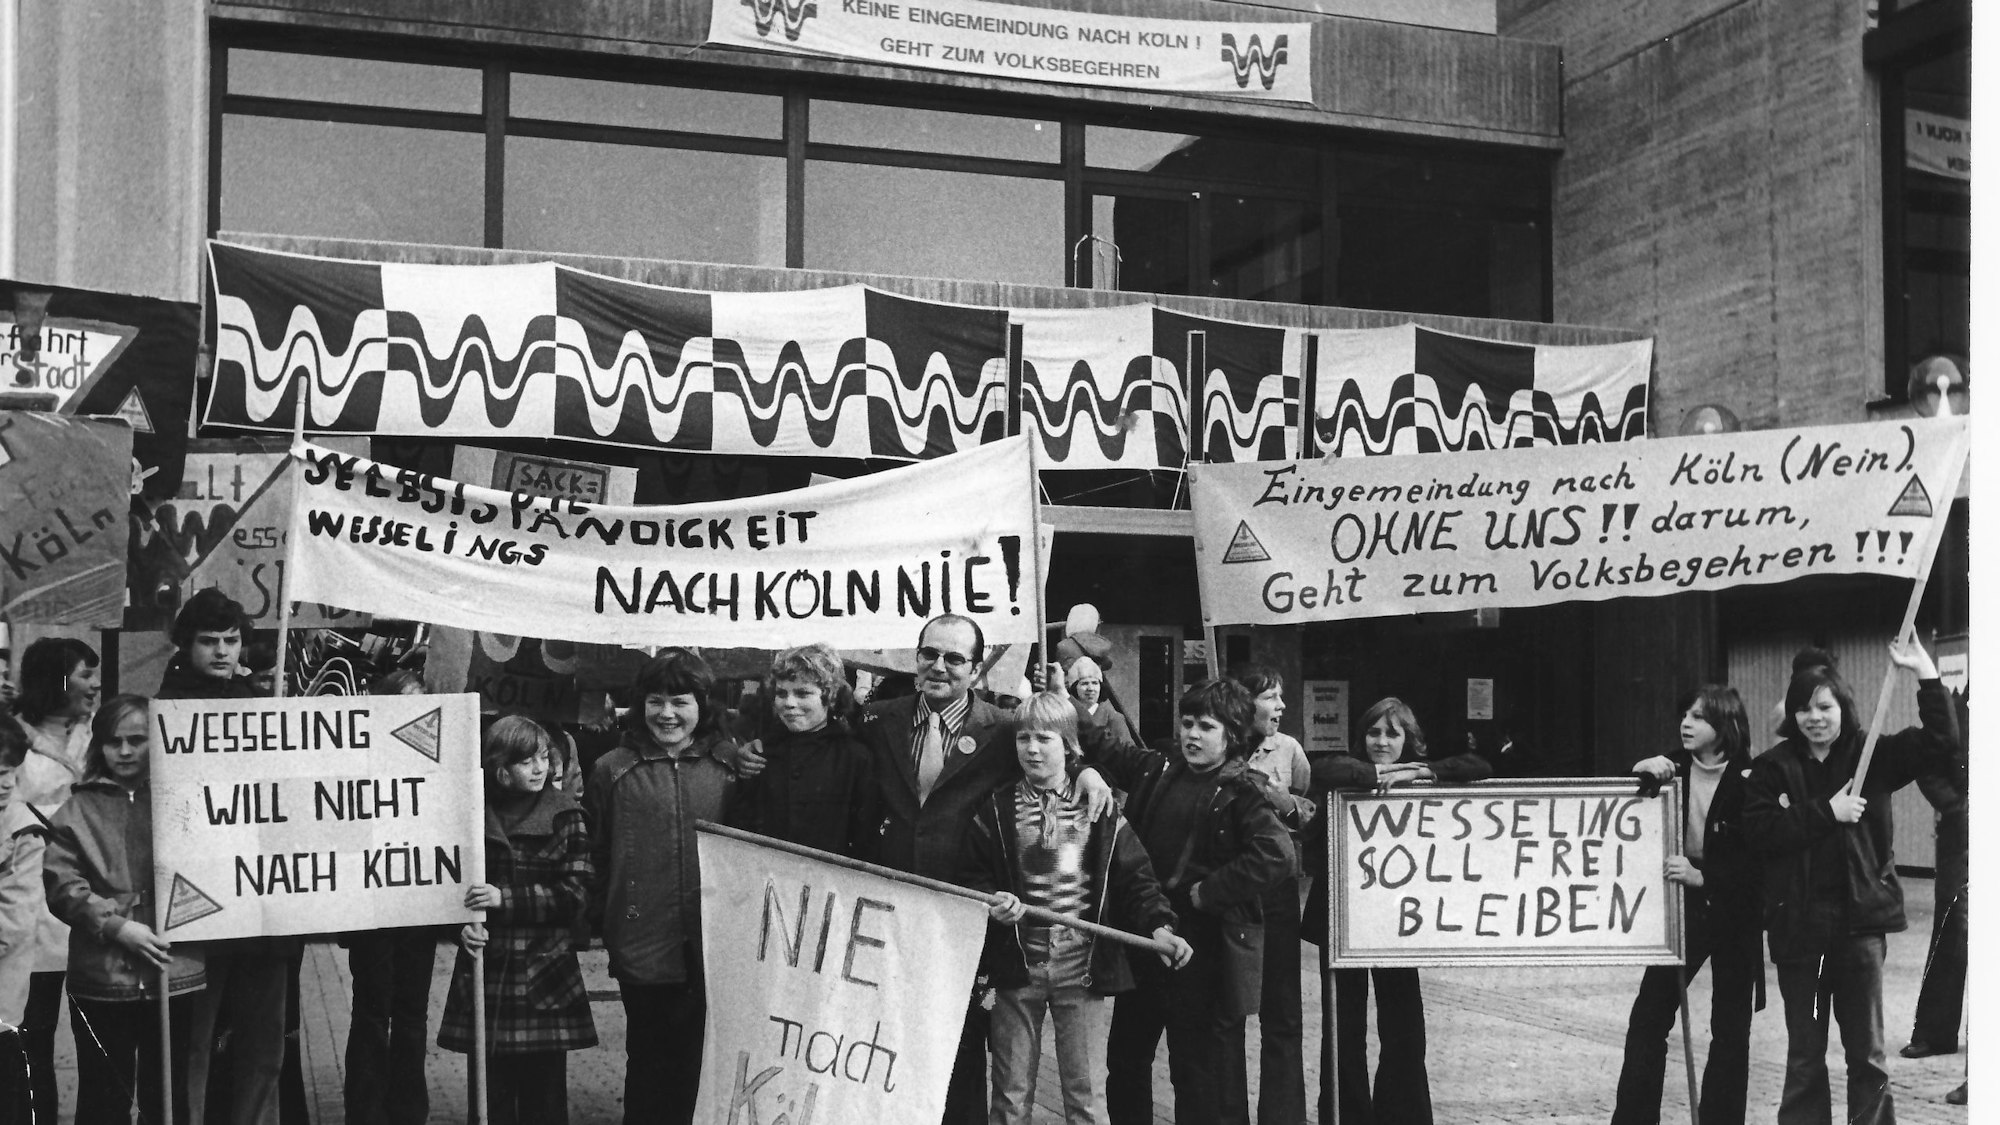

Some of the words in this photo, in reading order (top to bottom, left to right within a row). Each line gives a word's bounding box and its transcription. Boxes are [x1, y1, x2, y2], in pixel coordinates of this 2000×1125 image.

[843, 0, 900, 20] KEINE
[909, 7, 1069, 41] EINGEMEINDUNG
[1078, 27, 1130, 45] NACH
[880, 37, 934, 58] GEHT
[942, 45, 985, 64] ZUM
[994, 51, 1160, 79] VOLKSBEGEHREN
[1253, 464, 1530, 510] Eingemeindung
[1553, 461, 1635, 495] nach
[1670, 452, 1763, 487] Köln
[1331, 510, 1463, 563] OHNE
[1651, 501, 1811, 534] darum,
[595, 566, 739, 621] NACH
[755, 569, 880, 621] KÖLN
[1263, 567, 1367, 613] Geht
[1403, 572, 1498, 598] zum
[1530, 542, 1836, 591] Volksbegehren
[157, 709, 370, 754] WESSELING
[203, 782, 288, 825] WILL
[314, 777, 425, 821] NICHT
[1349, 797, 1643, 842] WESSELING
[235, 851, 336, 897] NACH
[364, 841, 462, 888] KÖLN
[1357, 842, 1482, 890] SOLL
[1514, 839, 1623, 880] FREI
[757, 878, 895, 991] NIE
[1398, 882, 1647, 937] BLEIBEN
[770, 1015, 897, 1093] nach
